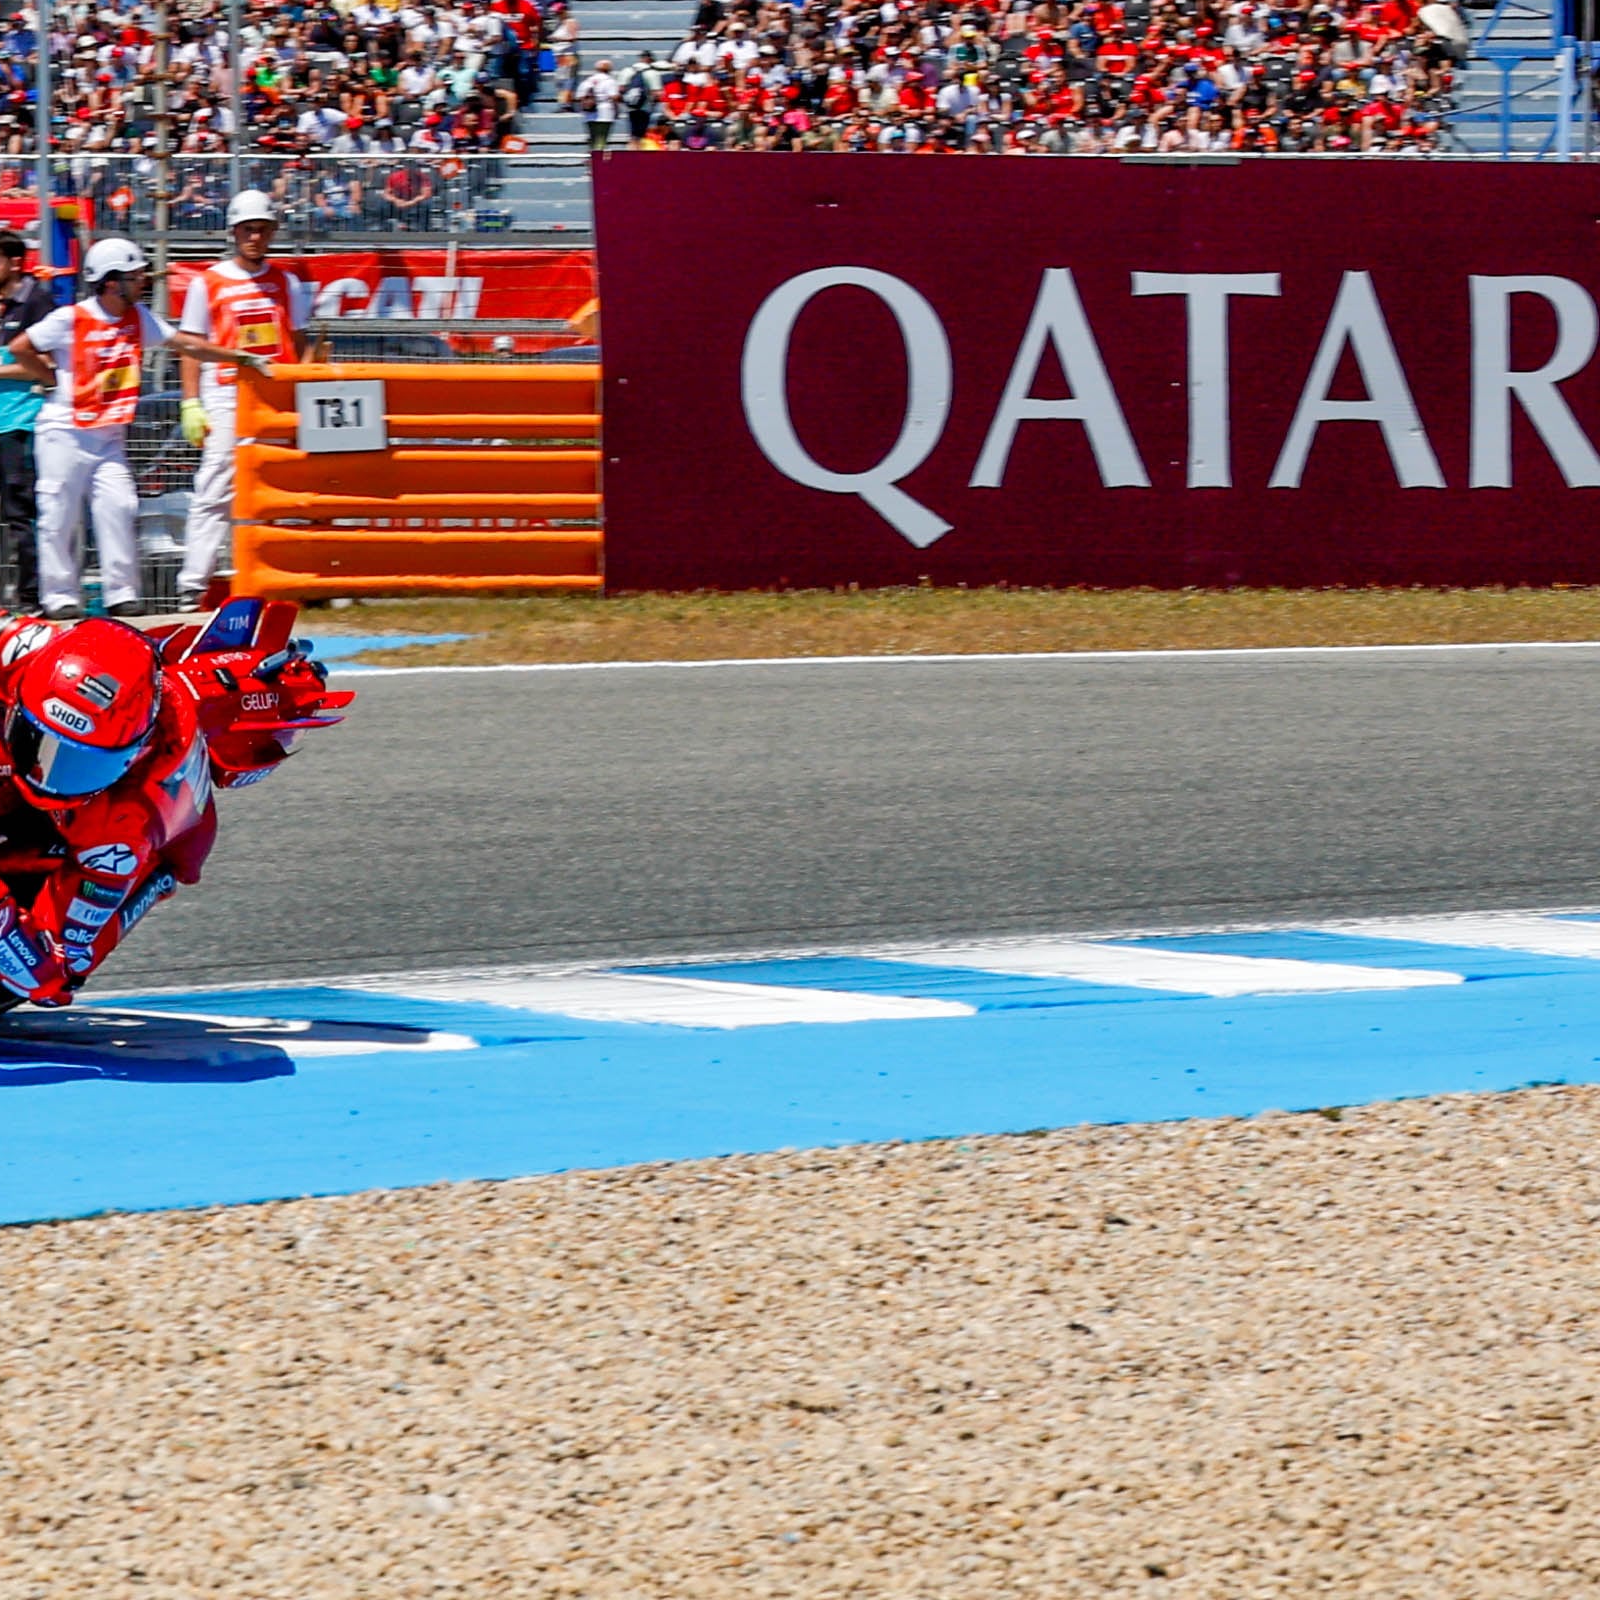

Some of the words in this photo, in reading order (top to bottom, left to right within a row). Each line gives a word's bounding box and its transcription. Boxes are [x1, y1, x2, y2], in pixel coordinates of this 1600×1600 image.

[314, 398, 364, 429] T3.1
[741, 266, 1600, 548] QATAR
[228, 615, 250, 631] TIM
[50, 704, 88, 732] SHOEI
[123, 874, 173, 929] Lenovo
[8, 930, 37, 966] Lenovo
